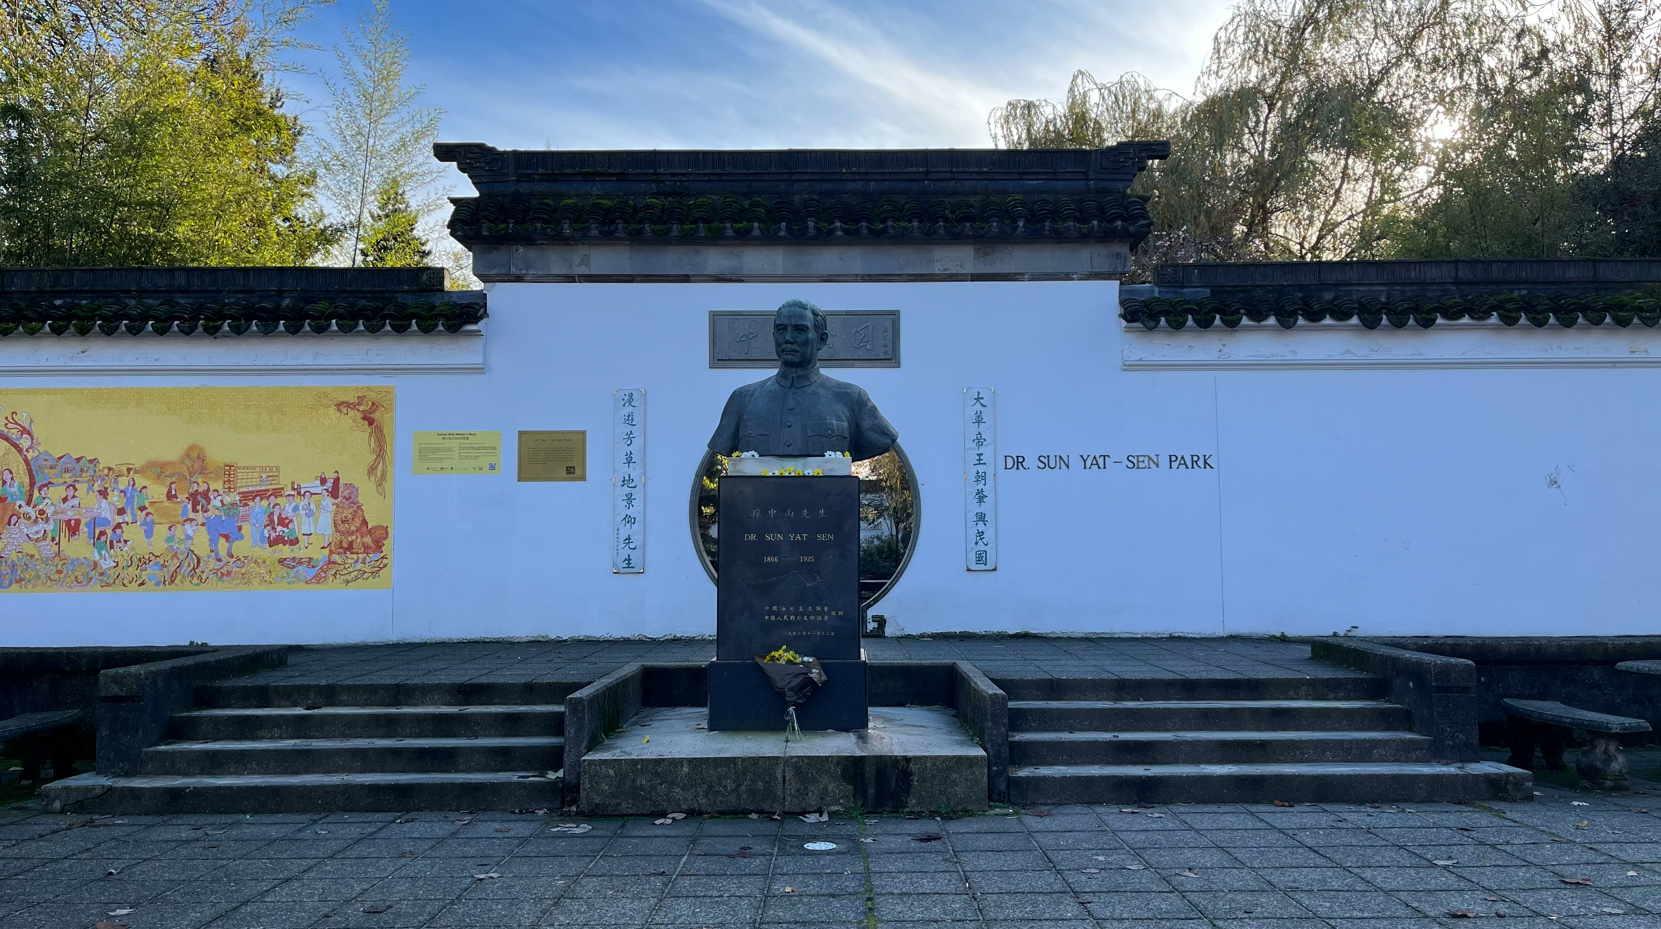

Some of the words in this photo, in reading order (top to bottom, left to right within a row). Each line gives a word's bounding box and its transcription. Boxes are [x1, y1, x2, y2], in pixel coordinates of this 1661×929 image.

[1004, 455, 1030, 470] DR.
[1037, 455, 1070, 470] SUN
[1168, 454, 1214, 470] PARK
[621, 392, 637, 569] 漫遊芳草地景仰先生
[750, 507, 828, 519] 孫中山先生
[744, 533, 759, 541] DR.
[765, 533, 784, 541] SUN
